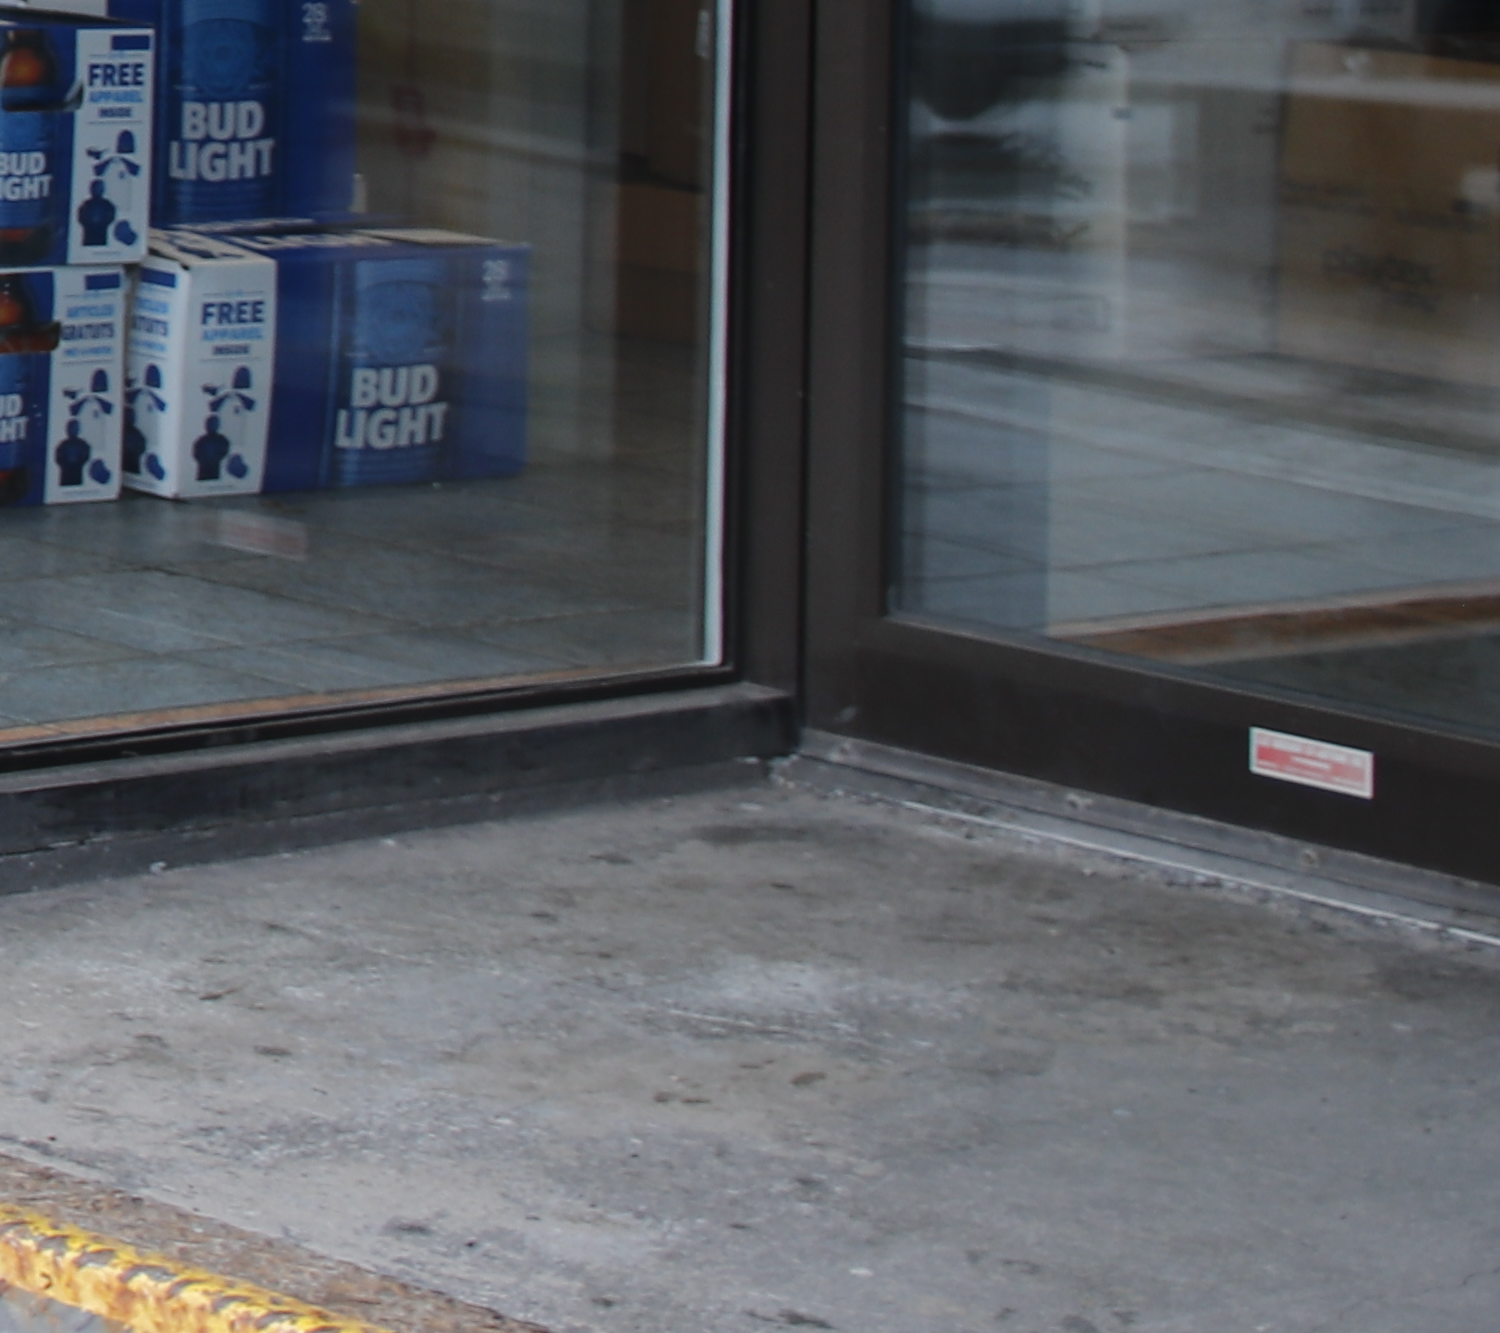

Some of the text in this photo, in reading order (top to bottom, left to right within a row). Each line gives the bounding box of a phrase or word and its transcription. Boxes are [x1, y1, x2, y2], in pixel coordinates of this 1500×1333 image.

[88, 63, 144, 86] FREE
[181, 100, 265, 140] BUD
[168, 137, 276, 182] LIGHT
[201, 300, 264, 325] FREE
[350, 364, 439, 408] BUD
[335, 402, 449, 450] LIGHT
